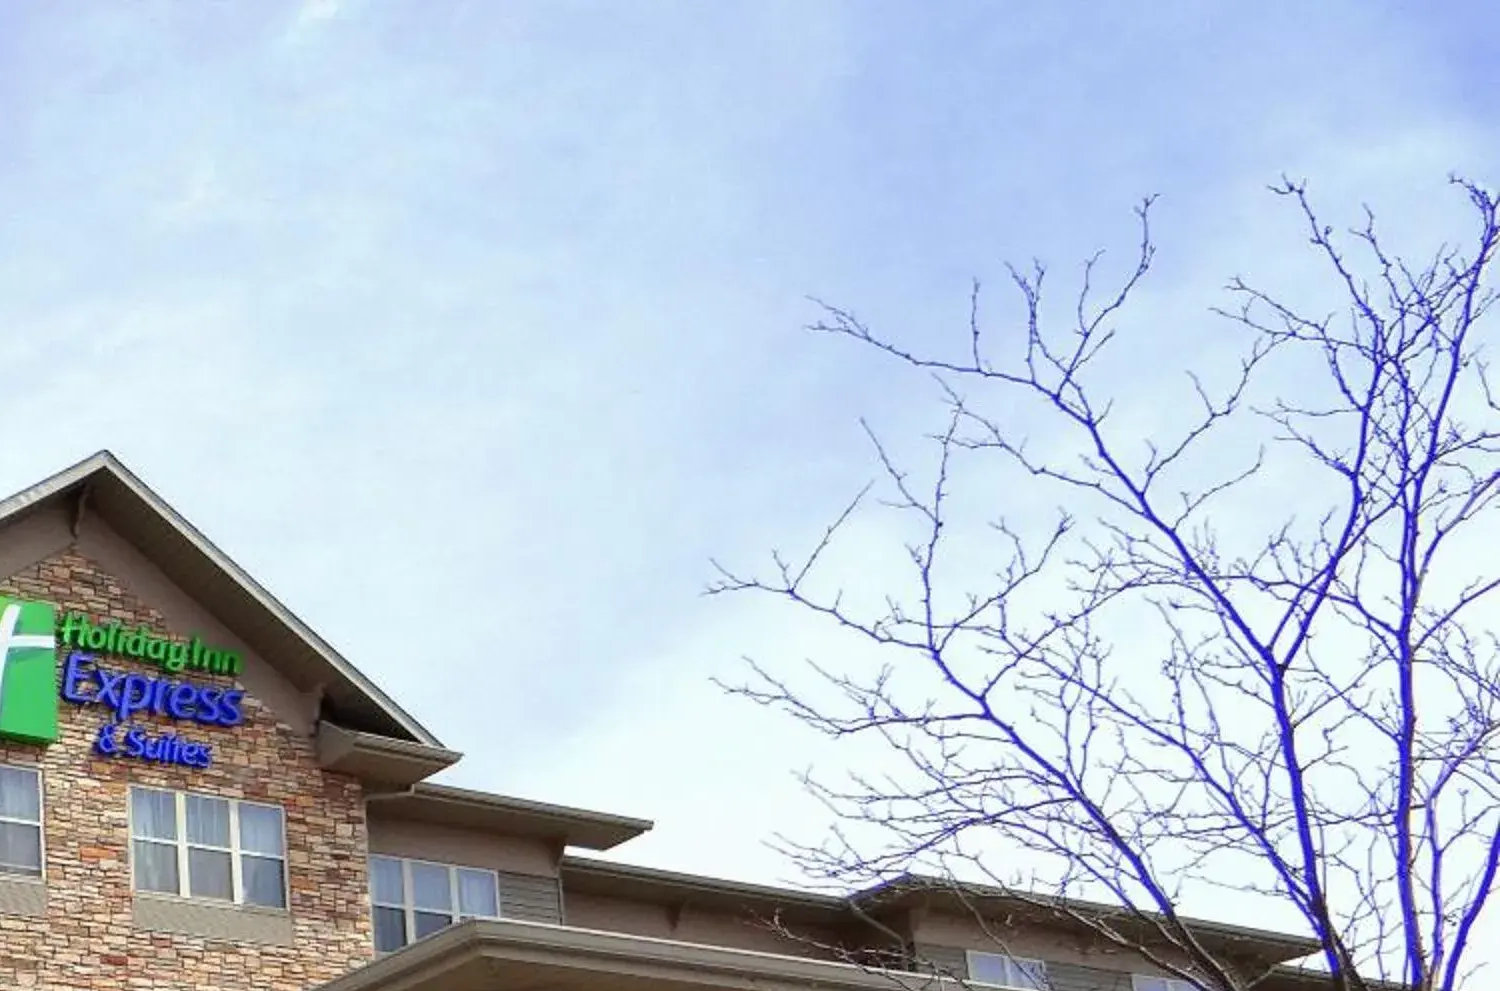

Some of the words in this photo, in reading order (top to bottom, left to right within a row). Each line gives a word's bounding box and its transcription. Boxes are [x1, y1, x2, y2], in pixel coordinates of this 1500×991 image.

[61, 612, 188, 671] Holiday
[190, 635, 244, 674] Inn
[61, 651, 245, 726] Express
[95, 724, 120, 757] &
[126, 726, 213, 769] Suites
